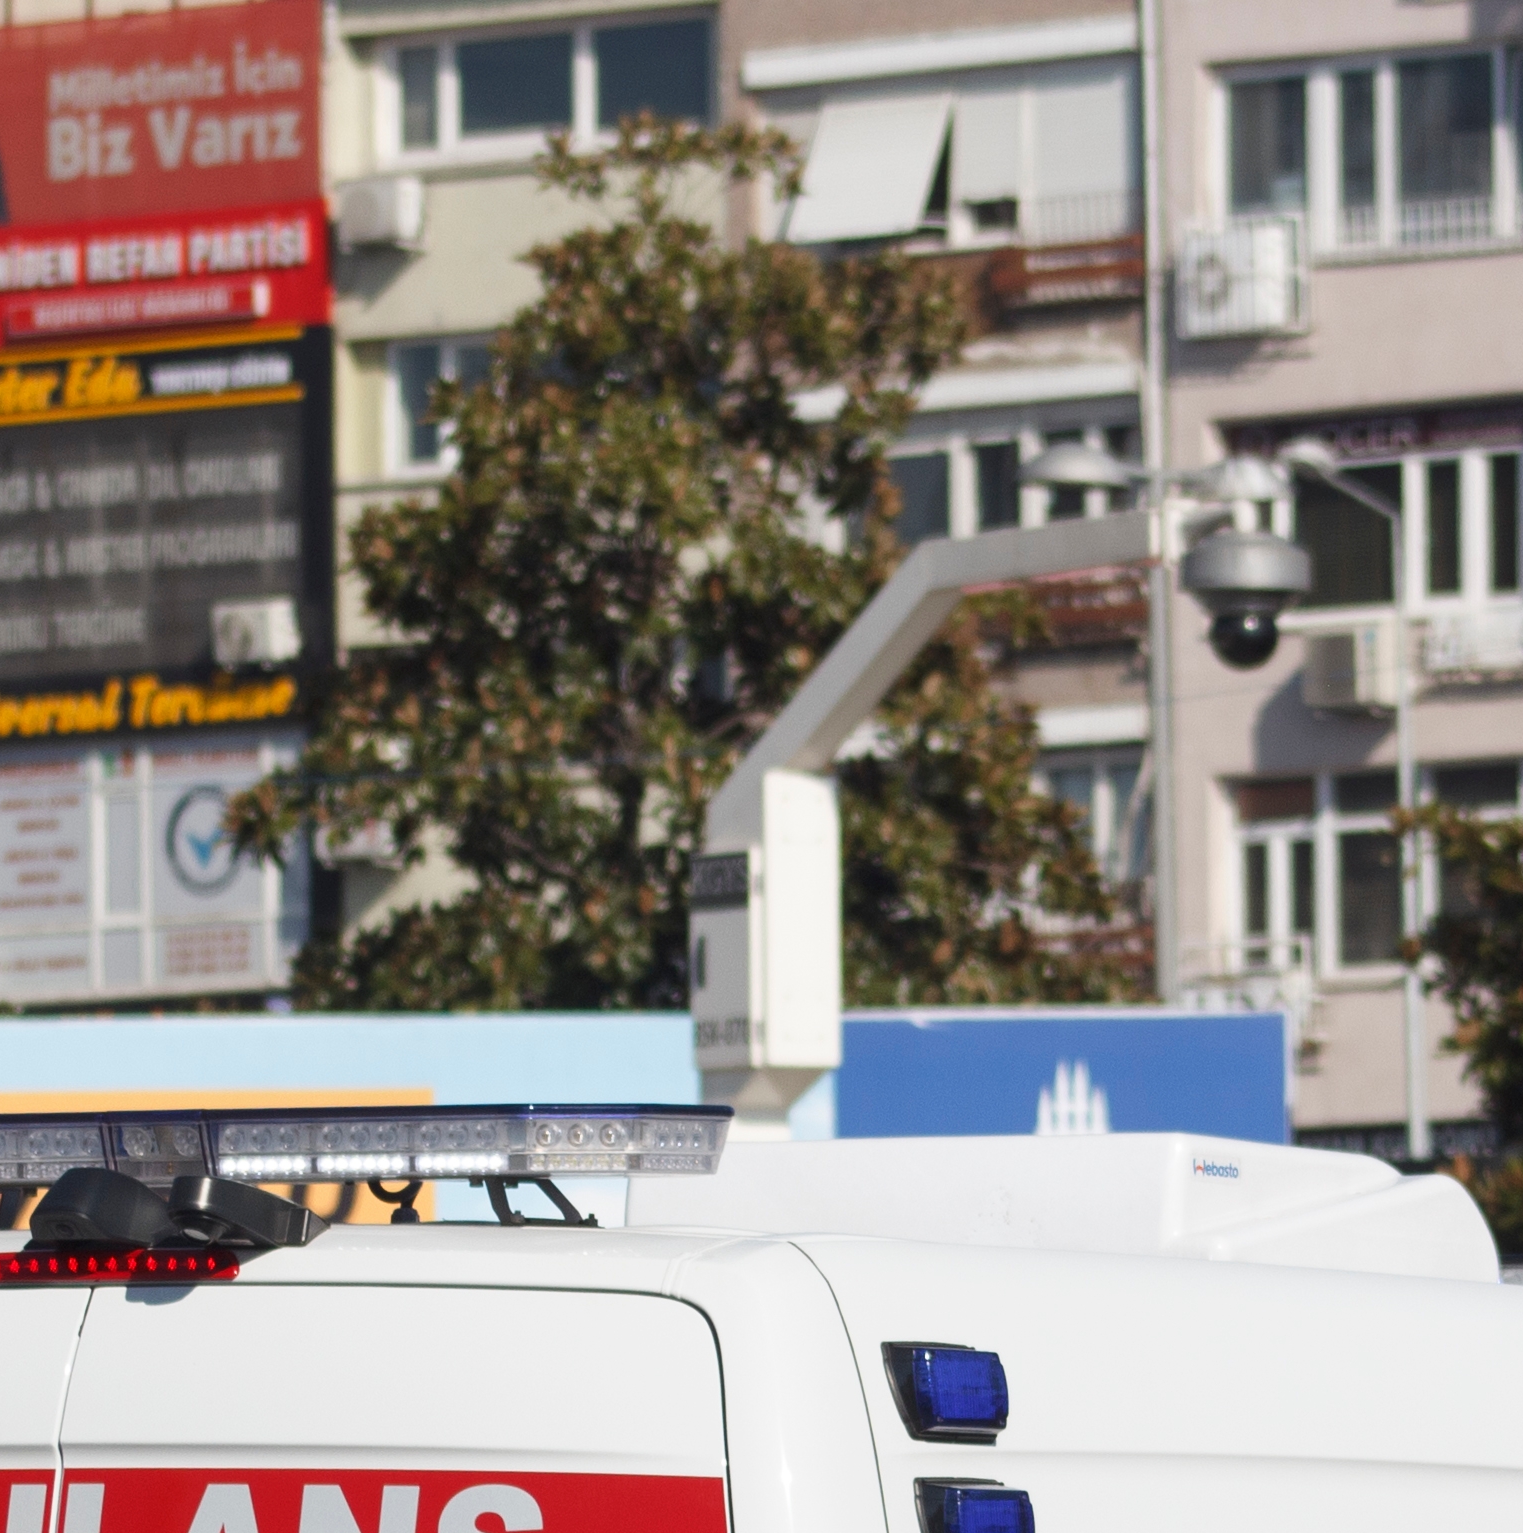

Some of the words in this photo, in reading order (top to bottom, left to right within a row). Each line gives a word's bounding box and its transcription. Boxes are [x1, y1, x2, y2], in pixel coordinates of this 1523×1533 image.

[48, 115, 134, 183] Biz
[148, 106, 302, 171] Varız
[1193, 1159, 1239, 1178] Webasto
